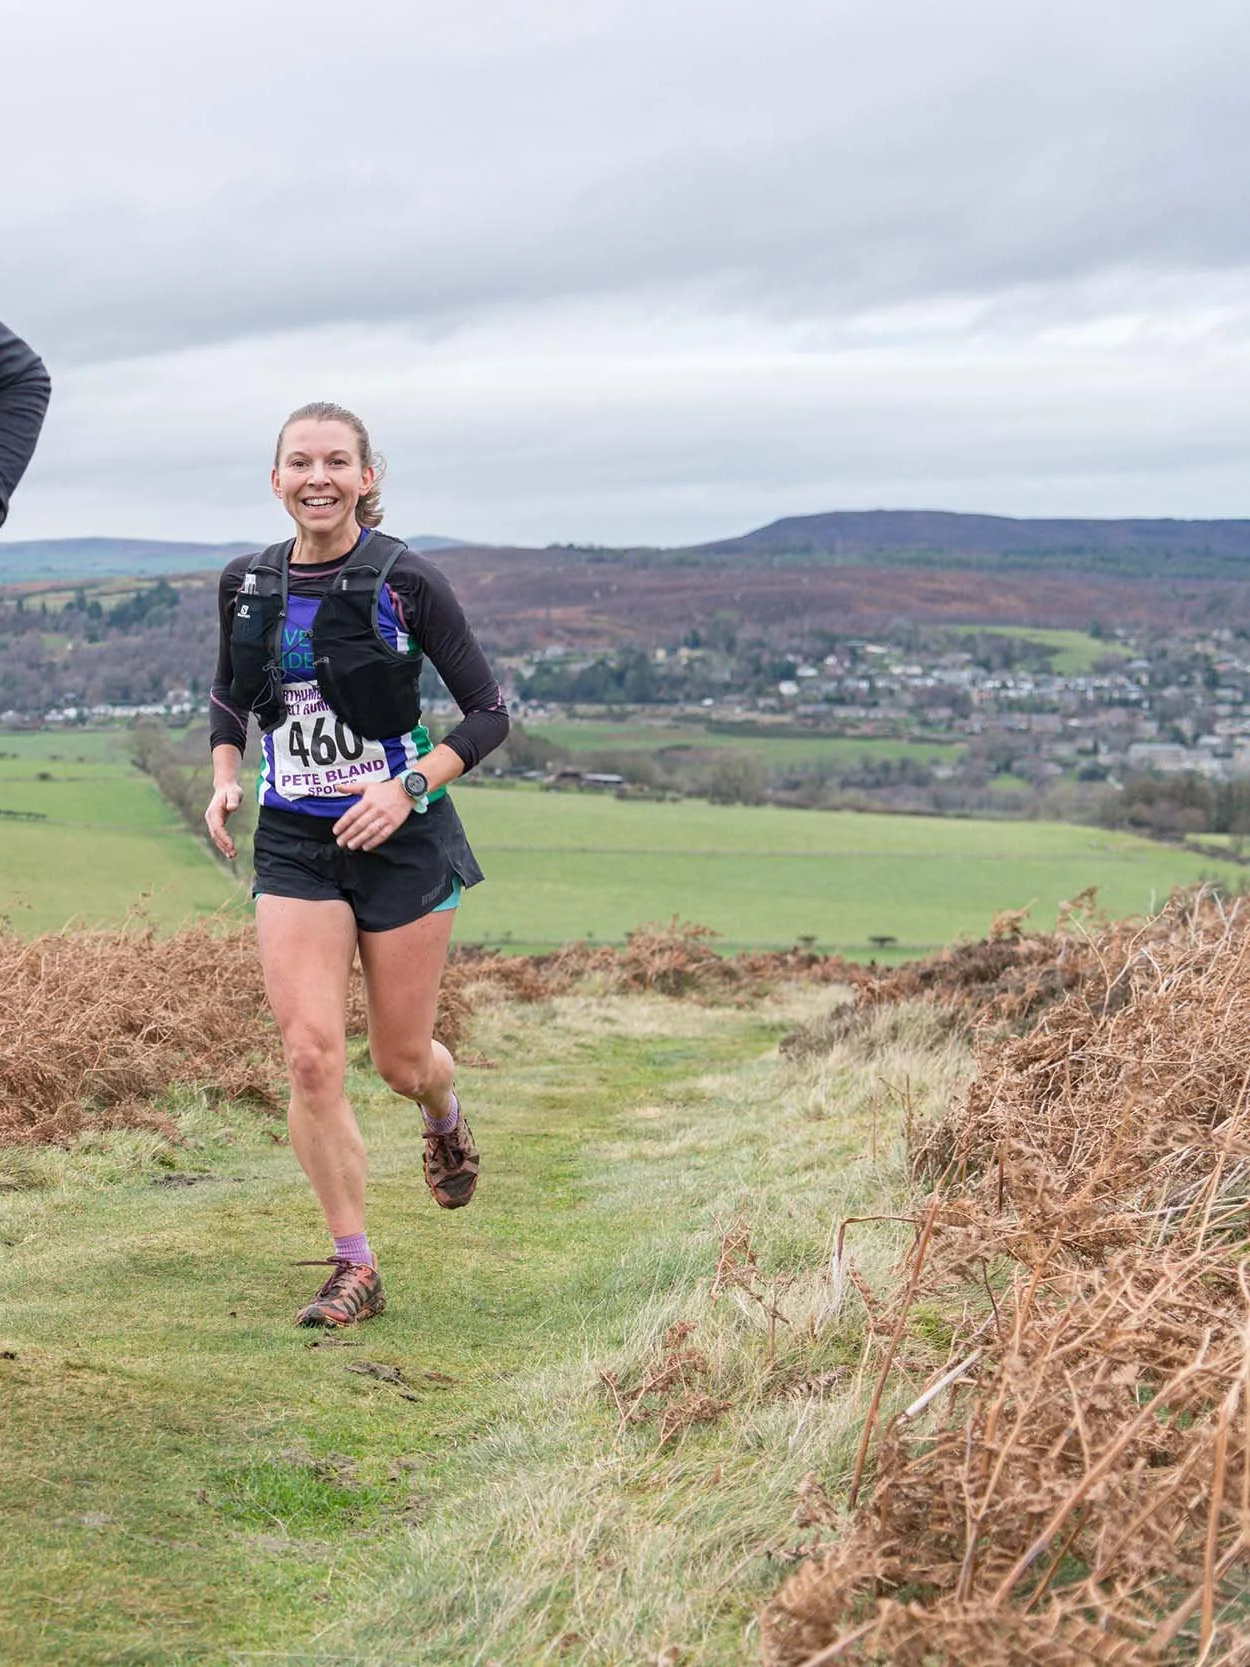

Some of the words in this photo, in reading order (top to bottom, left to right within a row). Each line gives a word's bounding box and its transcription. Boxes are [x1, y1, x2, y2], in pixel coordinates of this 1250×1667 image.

[289, 717, 364, 767] 460
[282, 774, 321, 787] PETE
[325, 759, 385, 784] BLAND
